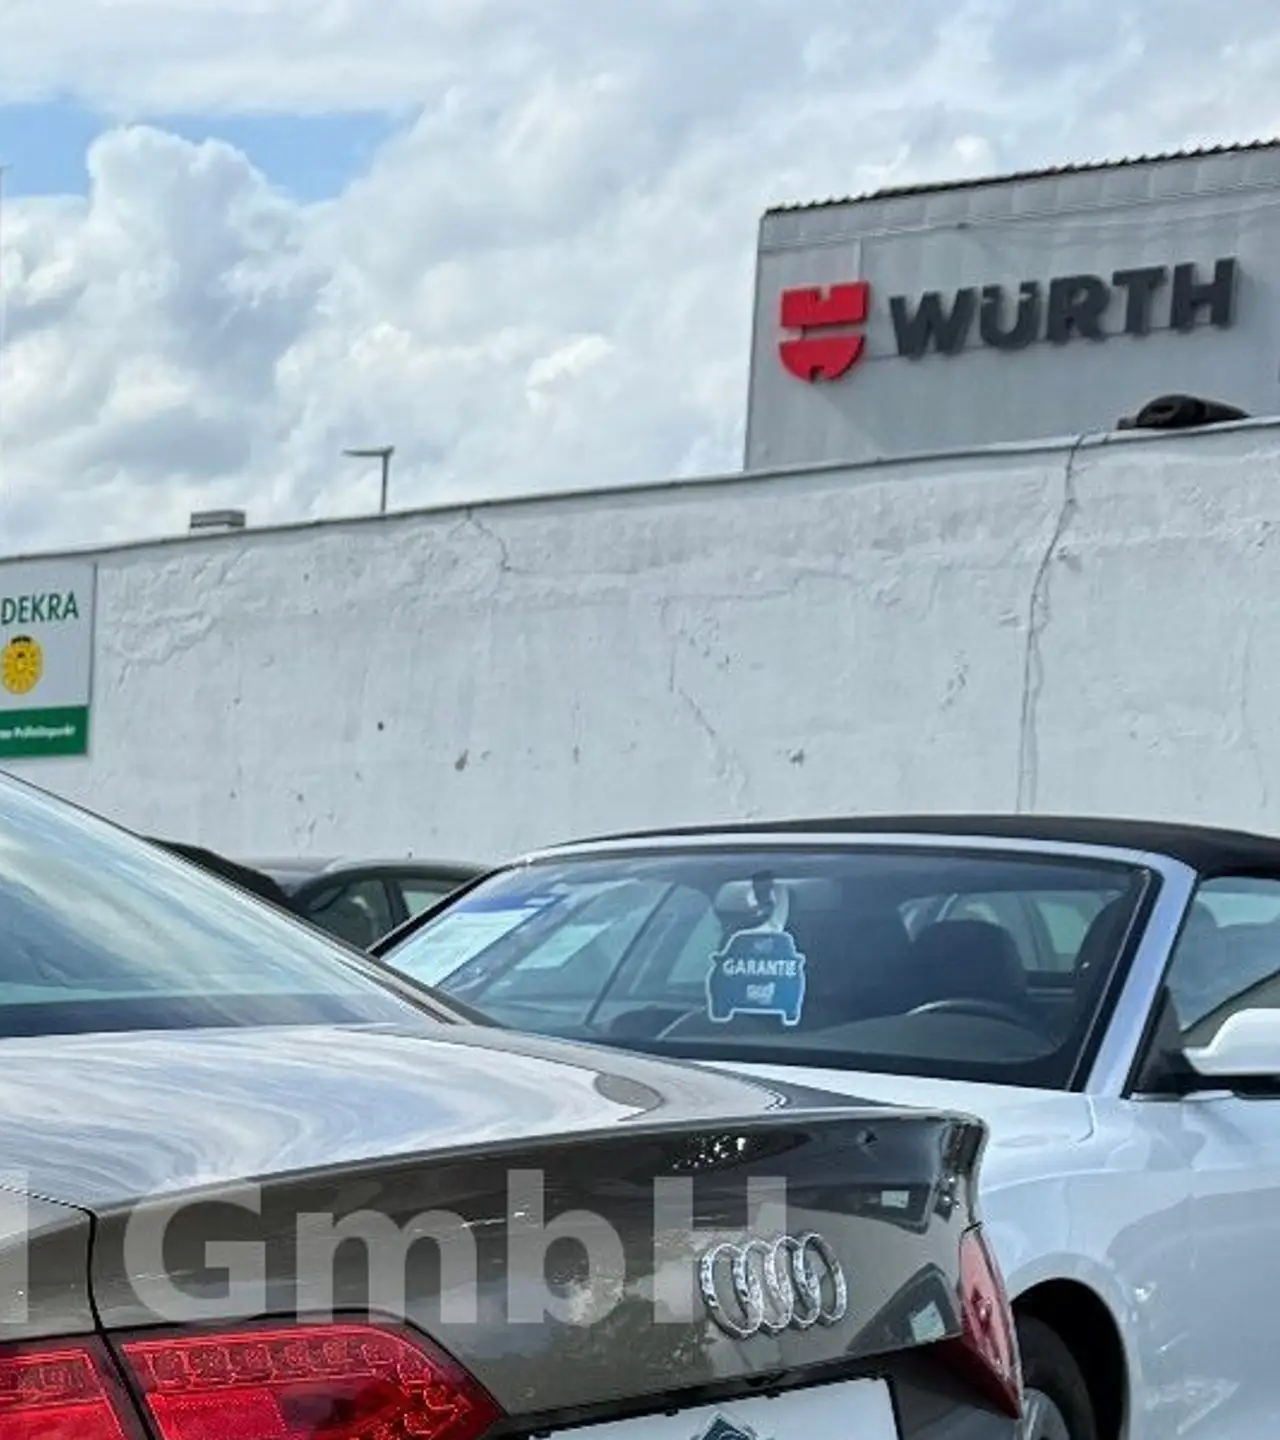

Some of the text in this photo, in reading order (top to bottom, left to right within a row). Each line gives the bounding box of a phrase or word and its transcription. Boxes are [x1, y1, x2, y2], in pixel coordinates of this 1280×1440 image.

[889, 257, 1236, 358] WÜRTH
[0, 590, 79, 626] DEKRA
[722, 957, 797, 977] GARANTIE
